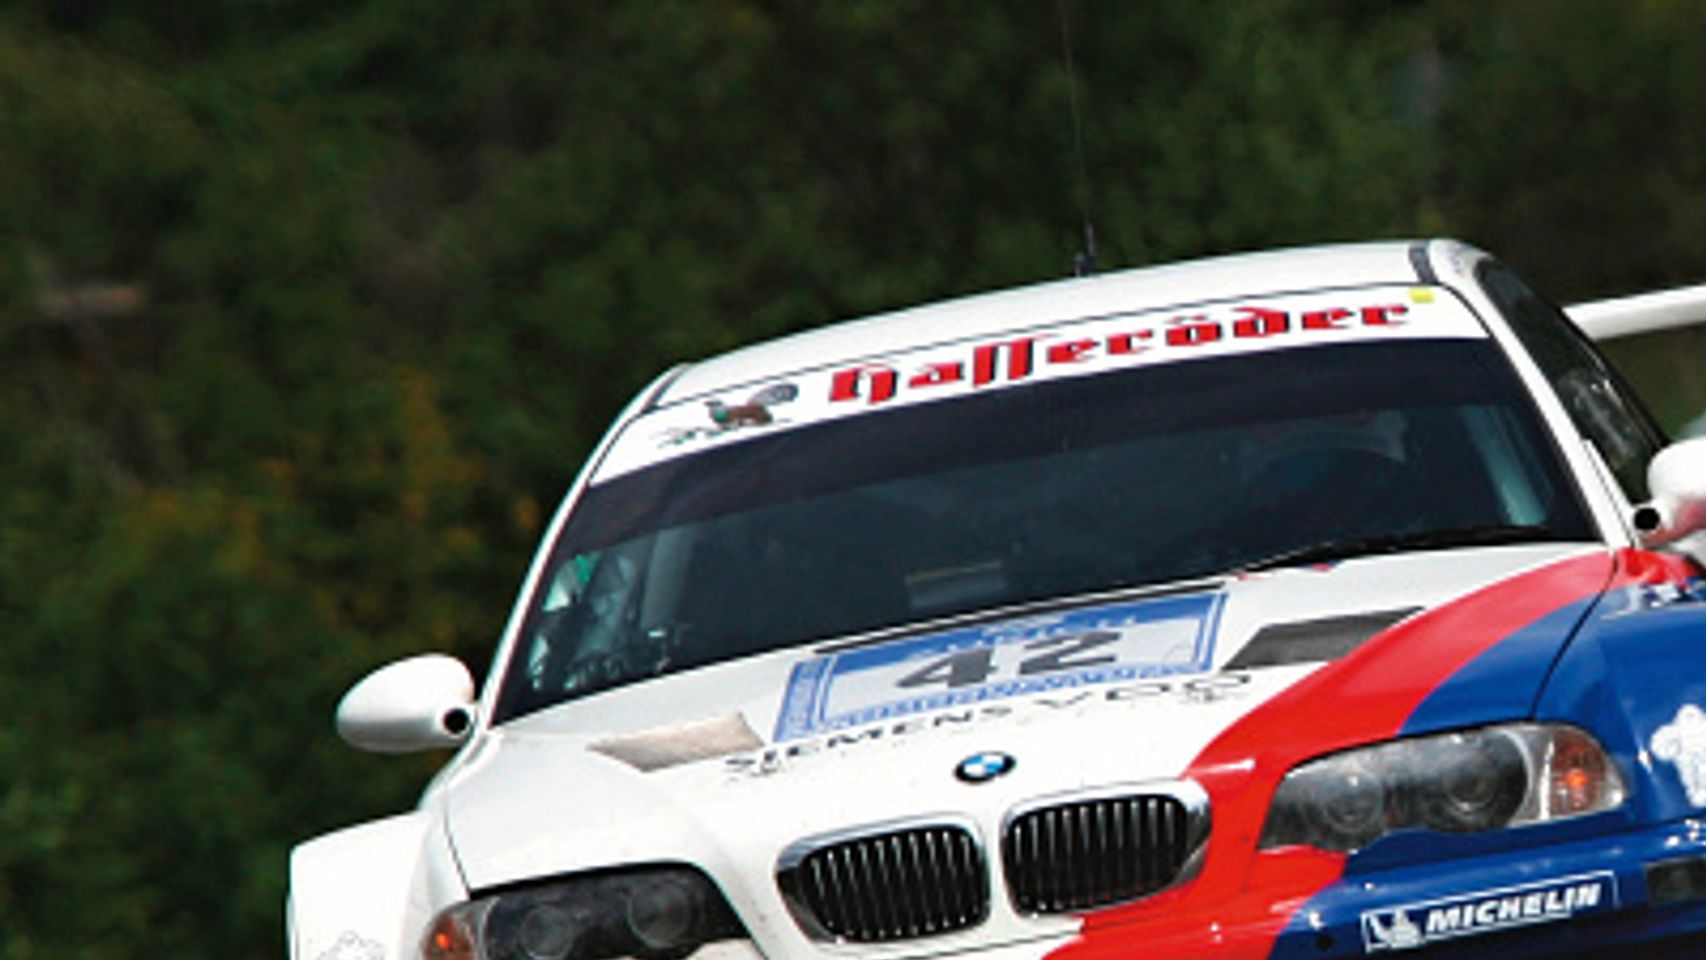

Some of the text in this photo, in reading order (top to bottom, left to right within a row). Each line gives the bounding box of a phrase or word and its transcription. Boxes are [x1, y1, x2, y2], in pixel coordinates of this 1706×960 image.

[896, 631, 1121, 687] 42
[724, 706, 1011, 765] SIEMENS
[1426, 882, 1600, 933] MICHELIN
